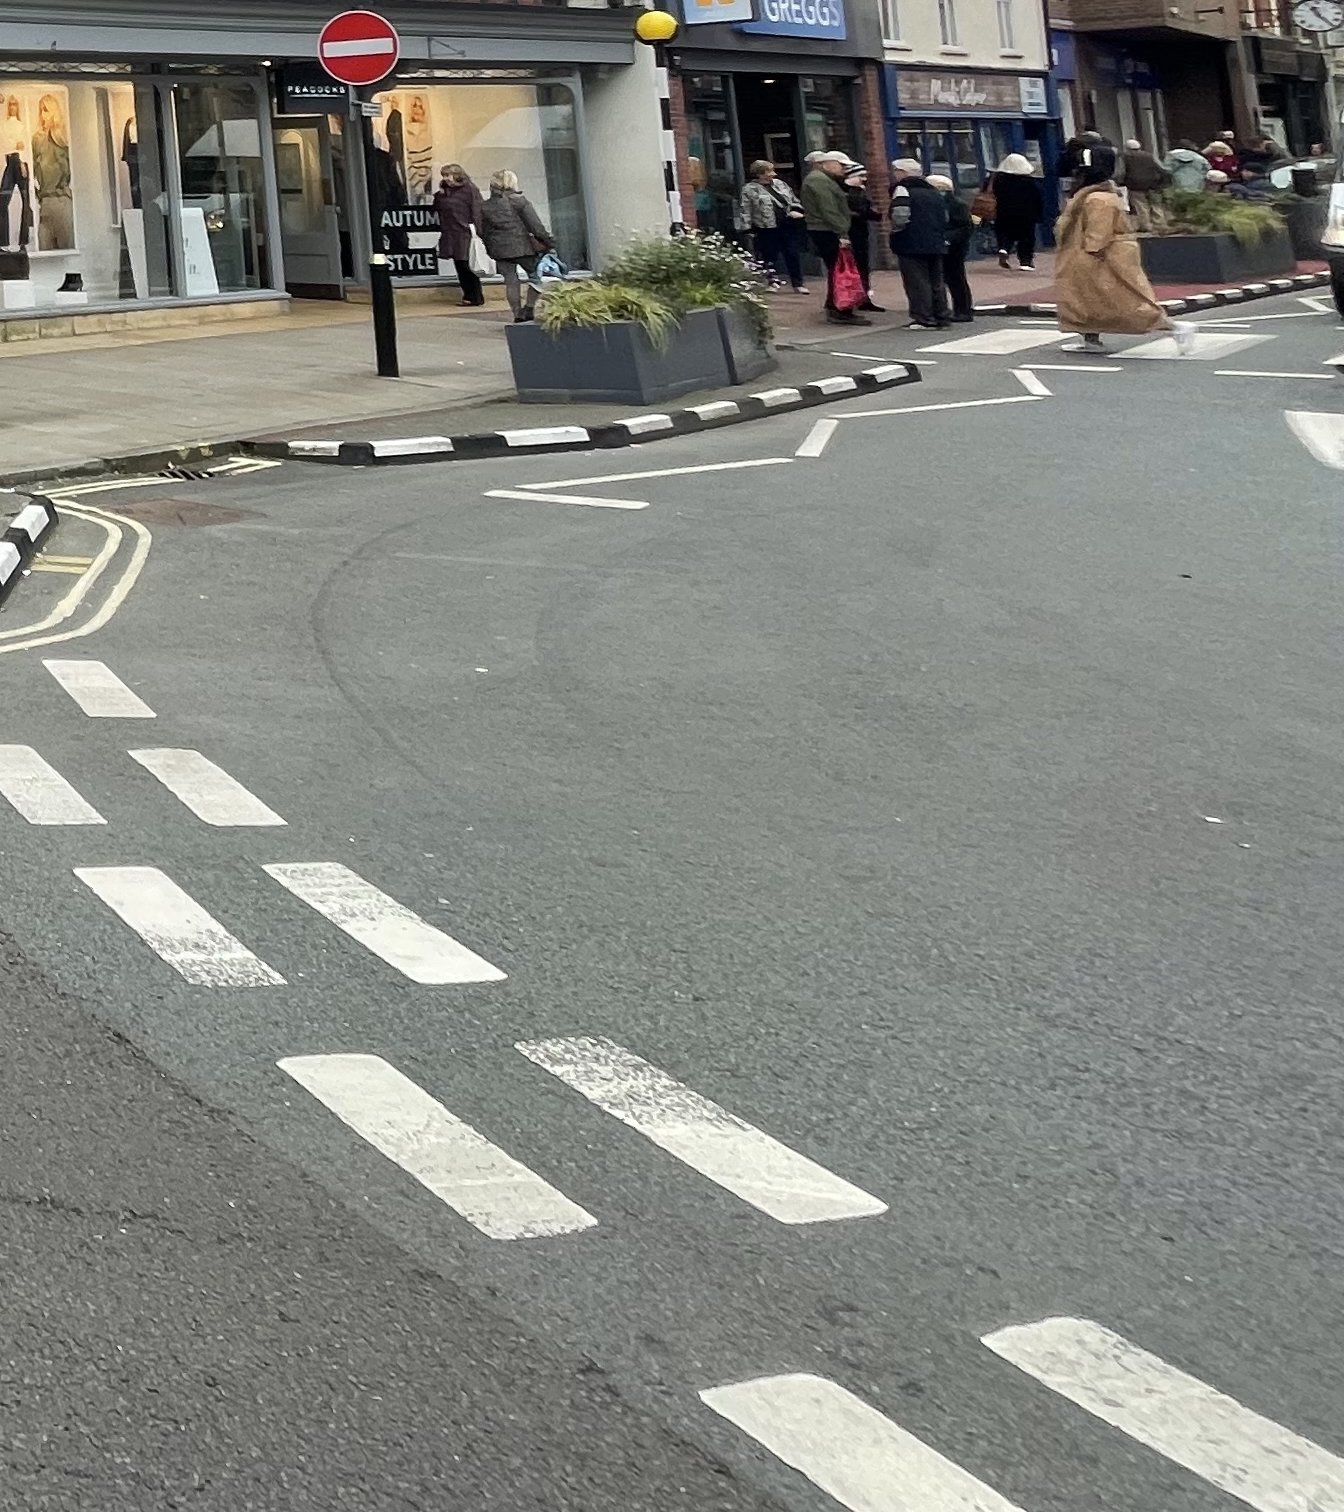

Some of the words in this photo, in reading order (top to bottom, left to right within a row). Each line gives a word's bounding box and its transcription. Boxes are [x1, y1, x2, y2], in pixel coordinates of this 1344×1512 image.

[287, 85, 346, 94] PEACOCKS
[380, 210, 441, 227] AUTUM
[385, 253, 436, 271] STYLE
